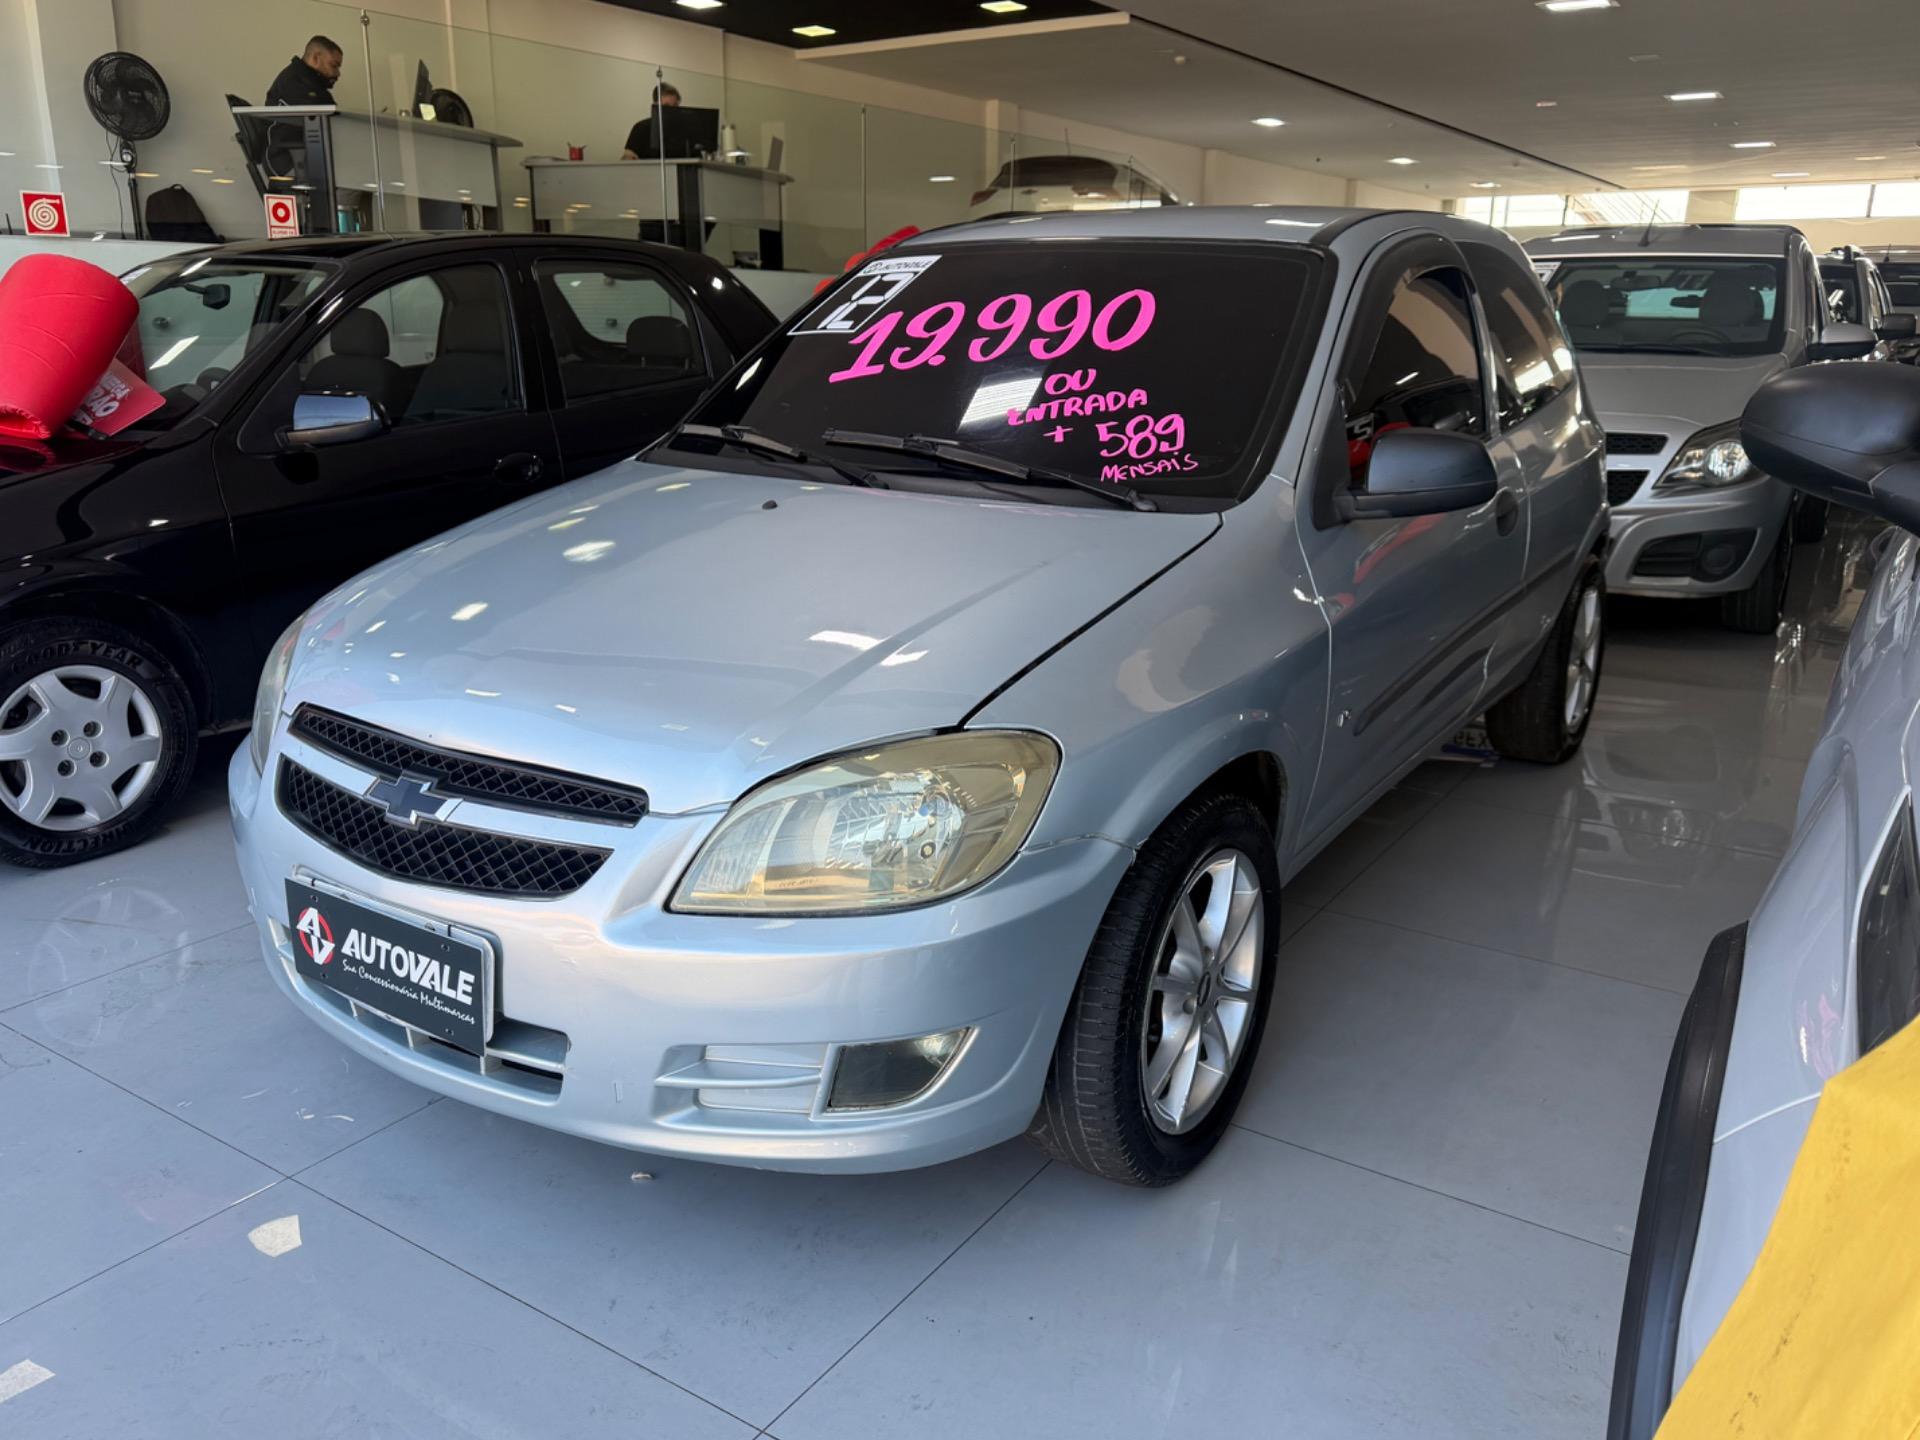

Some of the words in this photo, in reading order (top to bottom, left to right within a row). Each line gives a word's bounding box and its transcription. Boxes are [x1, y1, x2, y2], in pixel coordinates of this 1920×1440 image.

[828, 289, 1156, 383] 19.990
[1007, 387, 1148, 426] ENTRADA
[1044, 368, 1097, 395] OU
[1043, 425, 1074, 442] +
[1095, 413, 1186, 459] 589
[340, 928, 475, 1006] AUTOVALE
[342, 958, 358, 974] Sua
[420, 990, 477, 1025] Multimarcas
